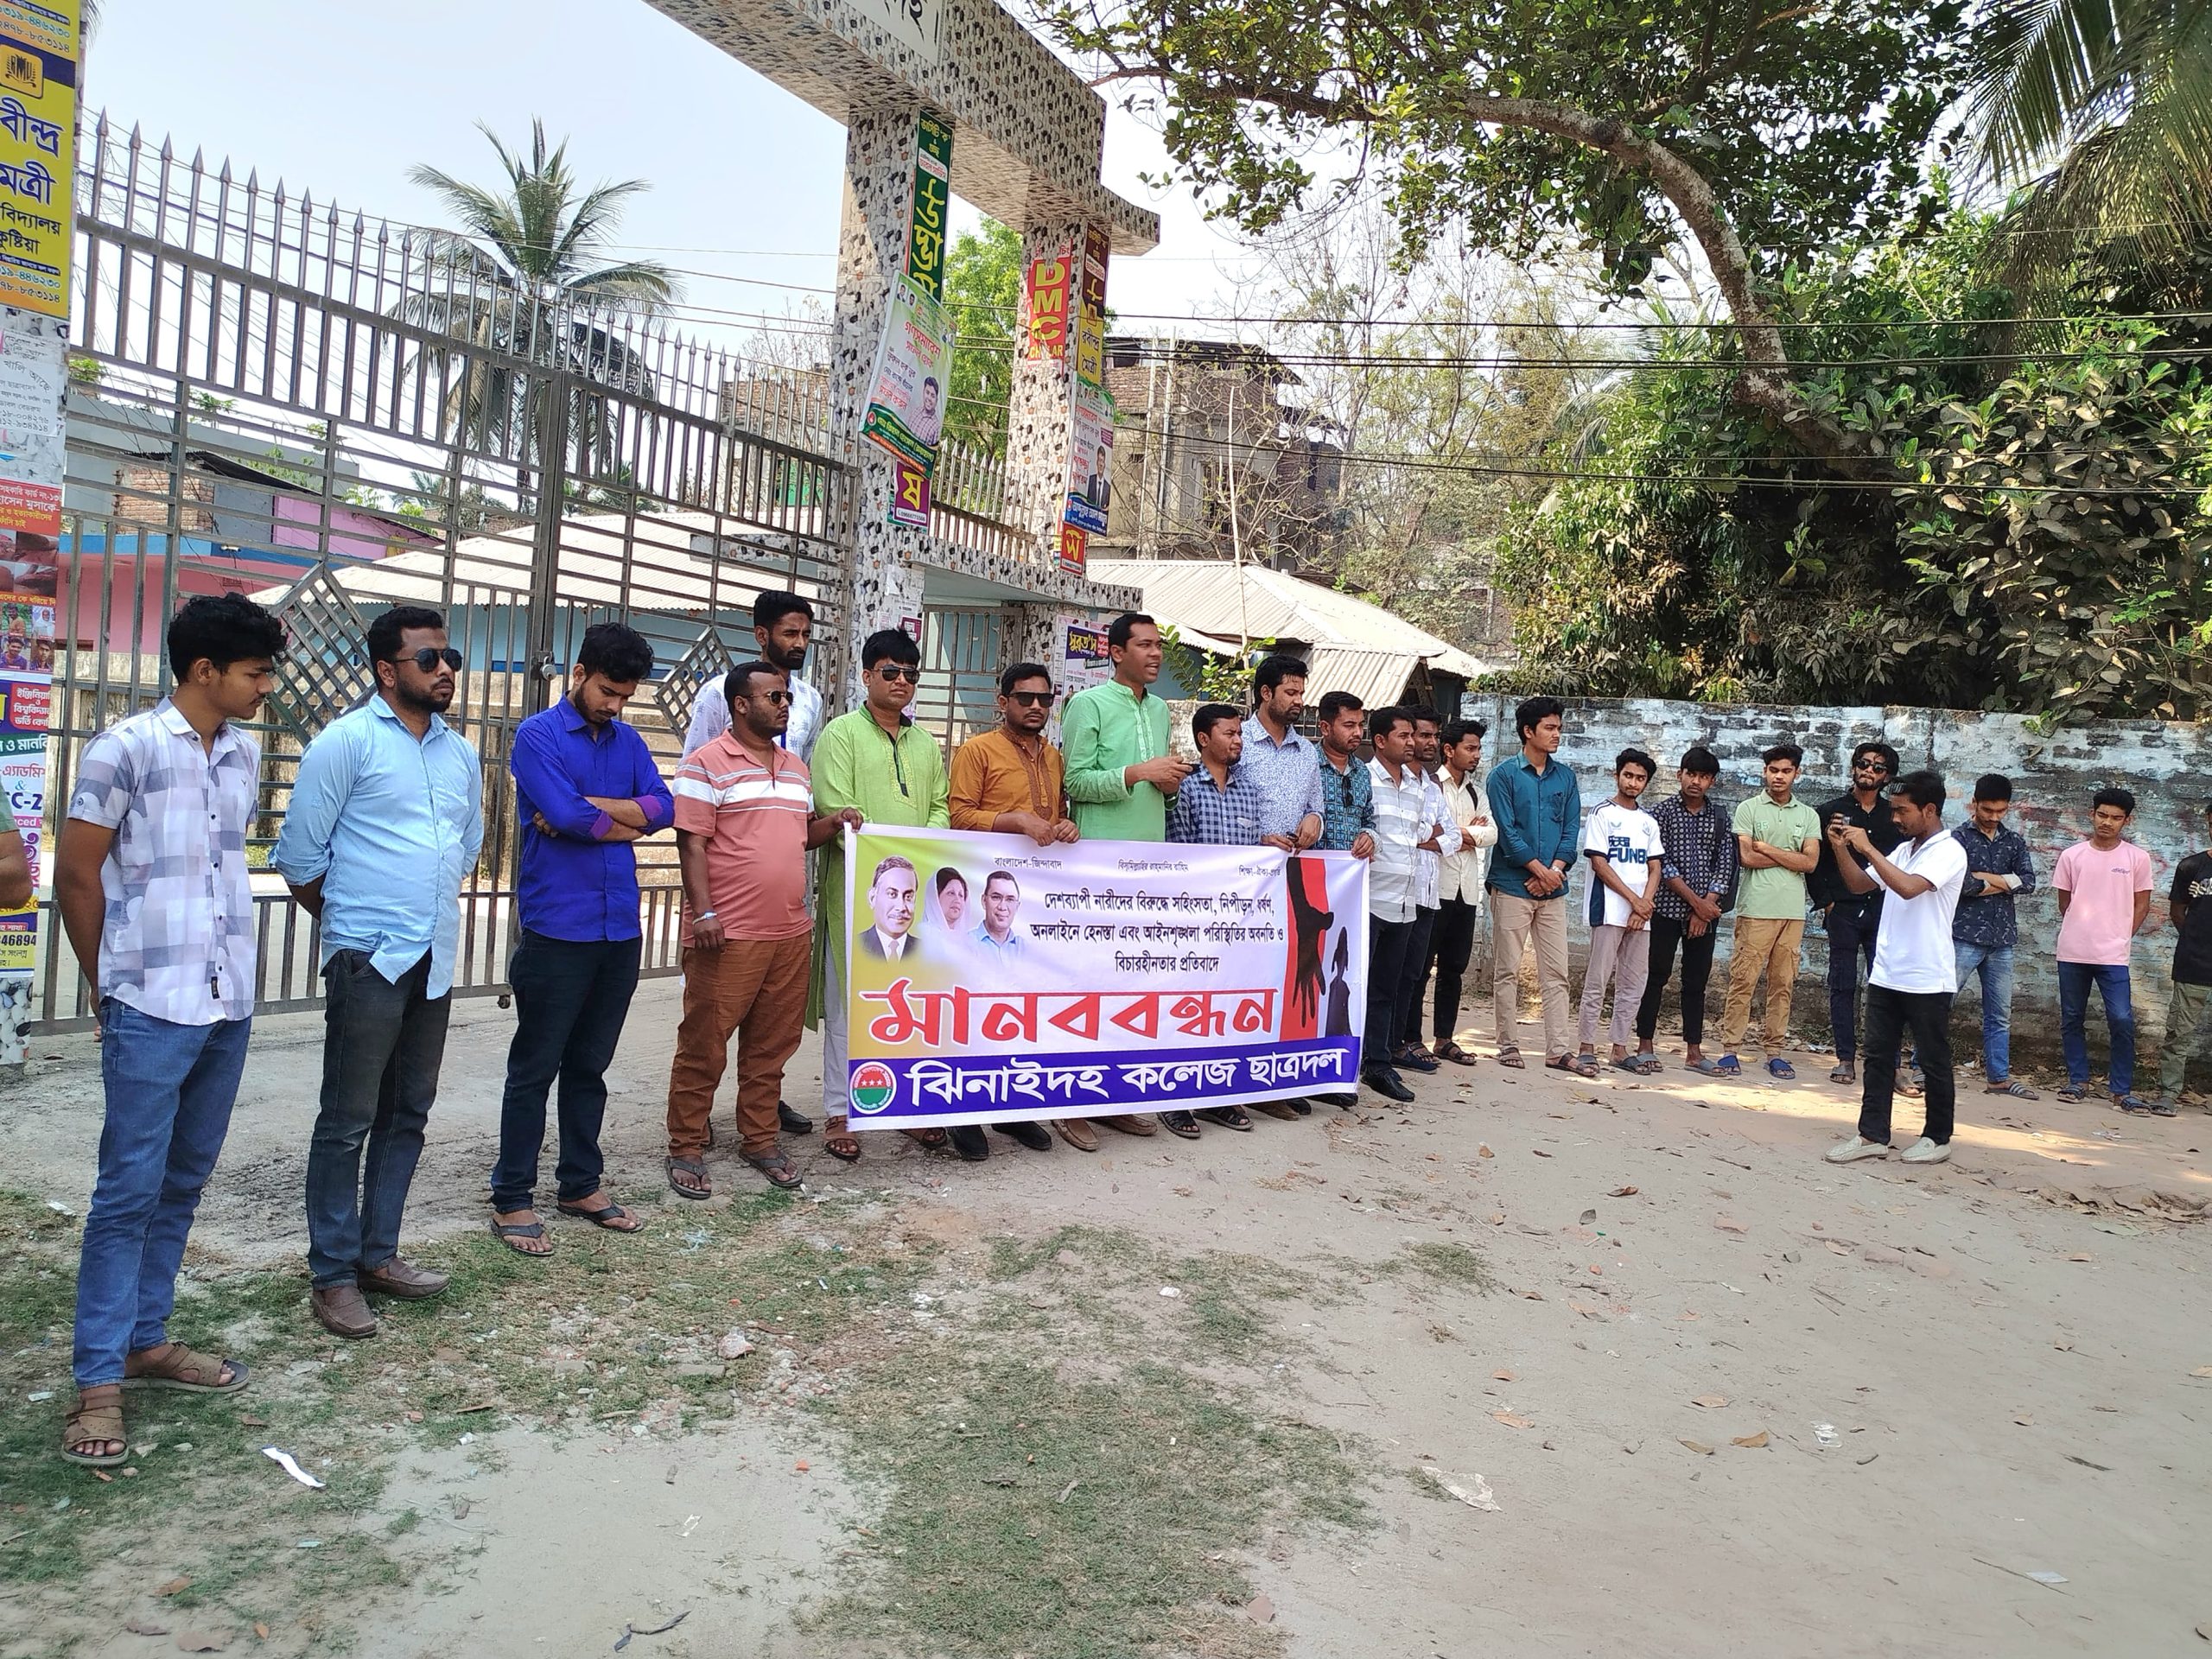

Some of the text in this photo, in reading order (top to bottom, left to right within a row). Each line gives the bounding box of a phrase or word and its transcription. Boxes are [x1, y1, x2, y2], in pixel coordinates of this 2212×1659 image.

[1045, 887, 1091, 910] দেশব্যাপী
[1093, 888, 1134, 912] নারীদের
[1136, 890, 1169, 913] বিরুদ্ধে
[1172, 891, 1217, 916] সহিংসতা,
[1030, 918, 1080, 943] অনলাইনে
[1084, 923, 1116, 944] হেনস্তা
[1119, 925, 1141, 943] এবং
[1204, 922, 1246, 946] পরিস্থিতির
[1248, 922, 1274, 943] অবনতি
[1277, 928, 1284, 941] ও
[1115, 950, 1219, 975] বিচারহীনতার প্রতিবাদে
[859, 977, 1279, 1046] মানববন্ধন
[903, 1056, 1111, 1107] ঝিনাইদহ
[1117, 1054, 1240, 1095] কলেজ
[1247, 1046, 1350, 1086] ছাত্রদল
